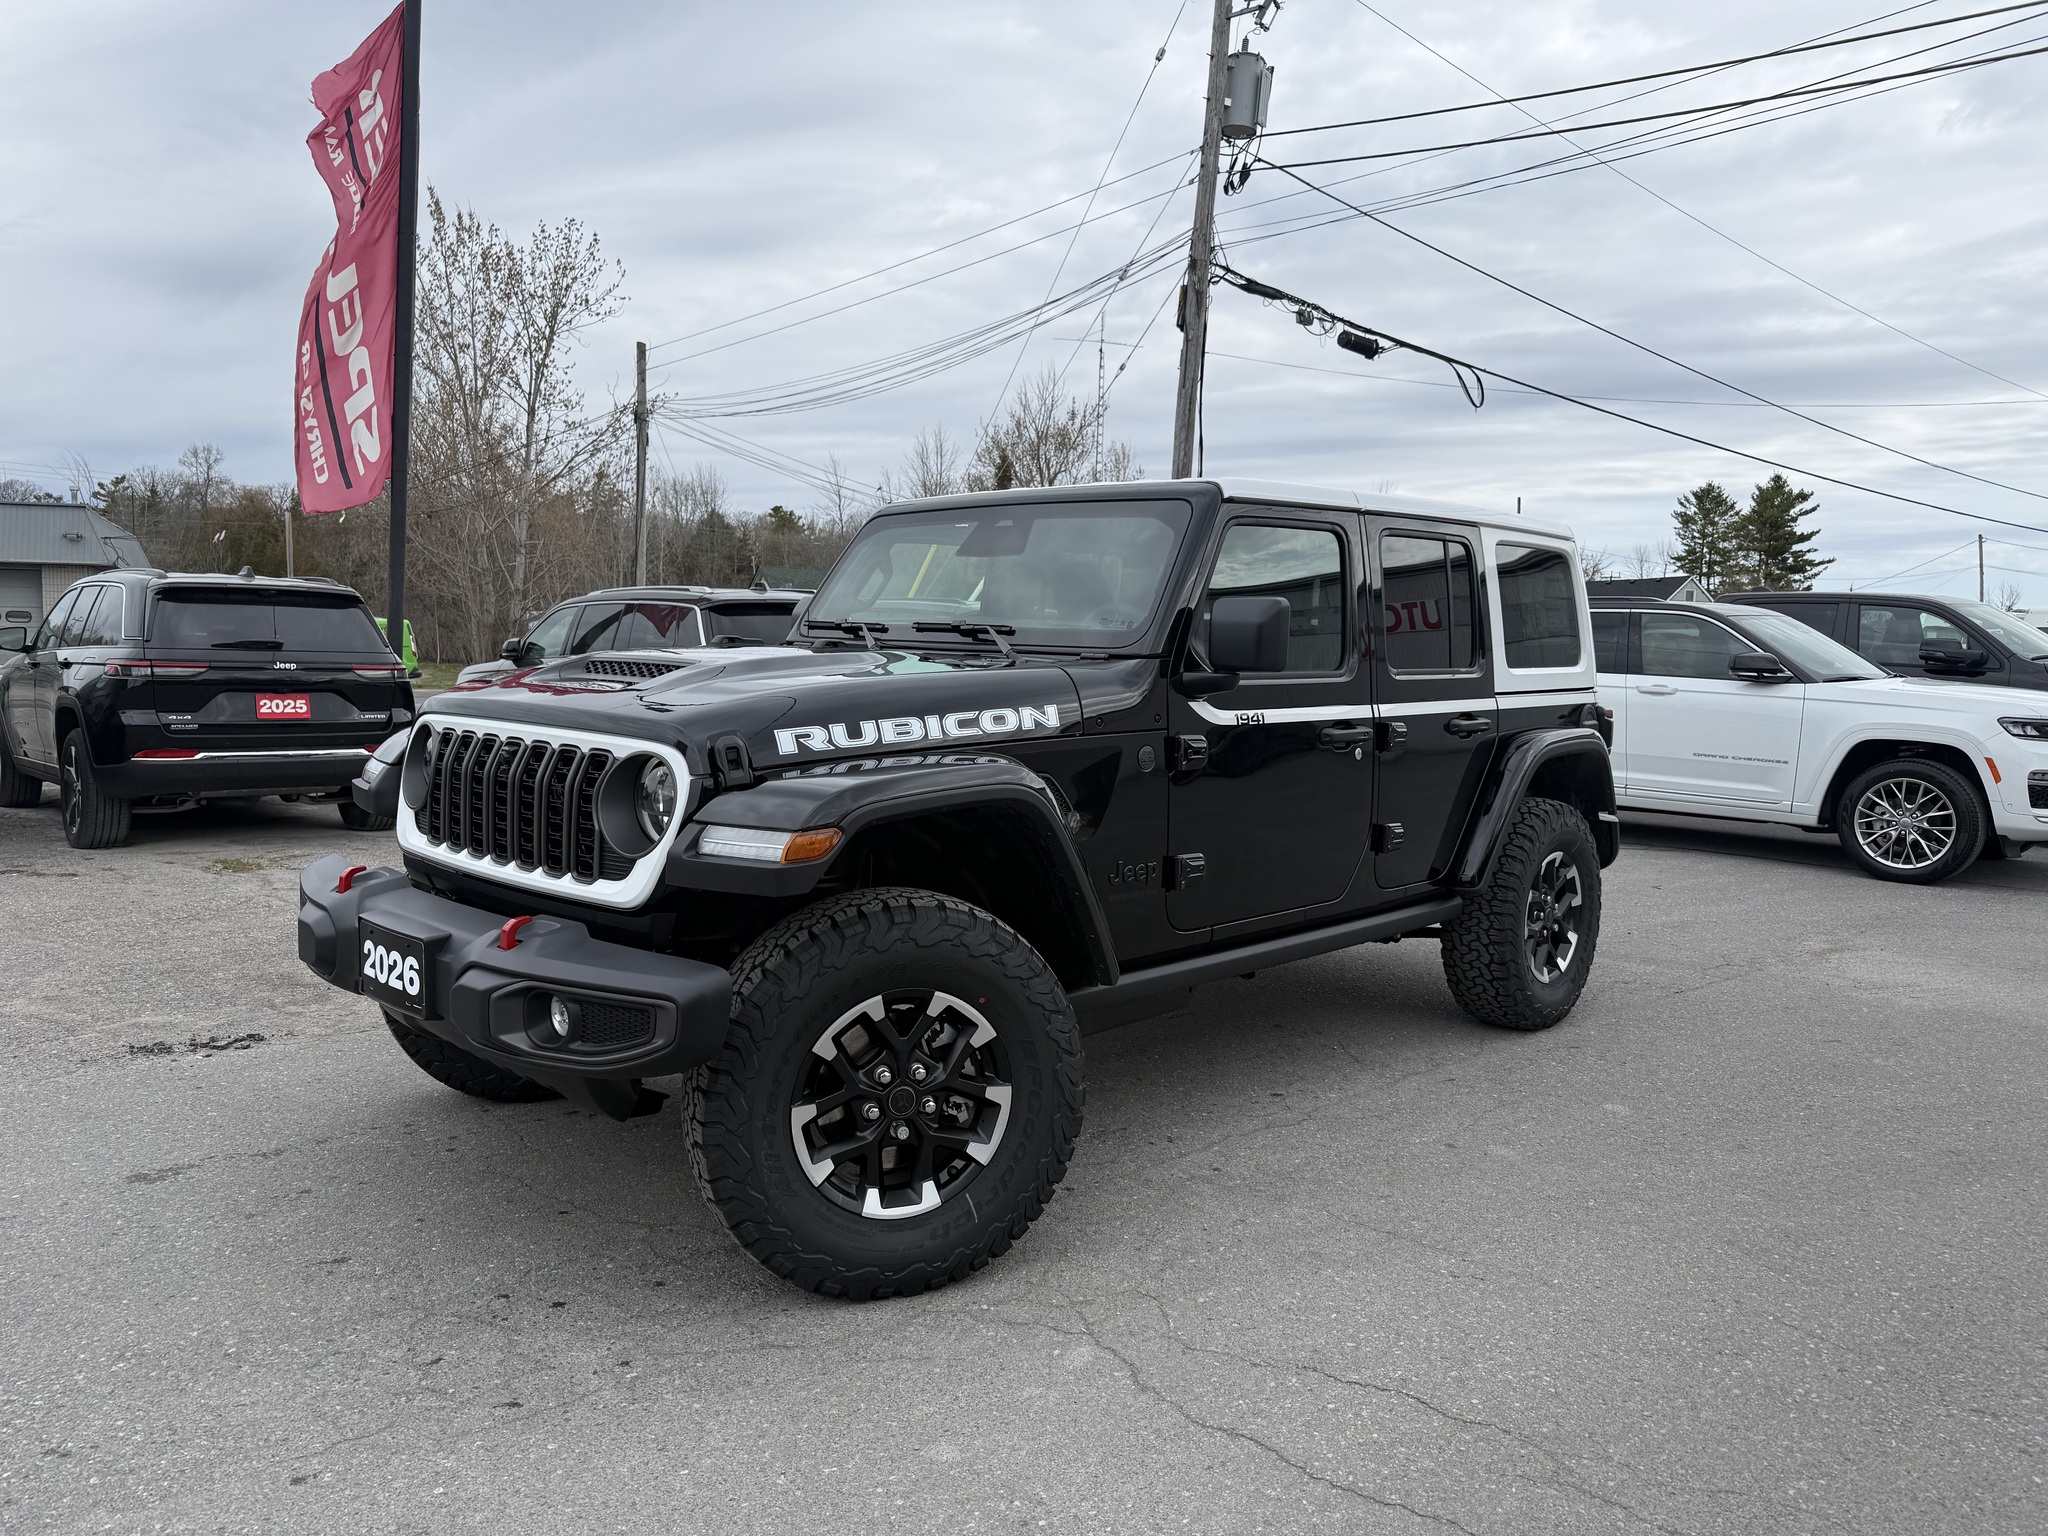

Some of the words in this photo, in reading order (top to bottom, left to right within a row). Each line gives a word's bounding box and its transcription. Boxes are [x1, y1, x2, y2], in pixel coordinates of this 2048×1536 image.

[273, 661, 297, 671] Jeep
[259, 699, 308, 714] 2025
[1233, 711, 1266, 725] 1941
[773, 703, 1061, 756] RUBICON
[1692, 752, 1729, 760] GRAND
[1731, 756, 1789, 765] CHEROKEE
[1108, 860, 1158, 886] Jeep
[363, 939, 420, 996] 2026
